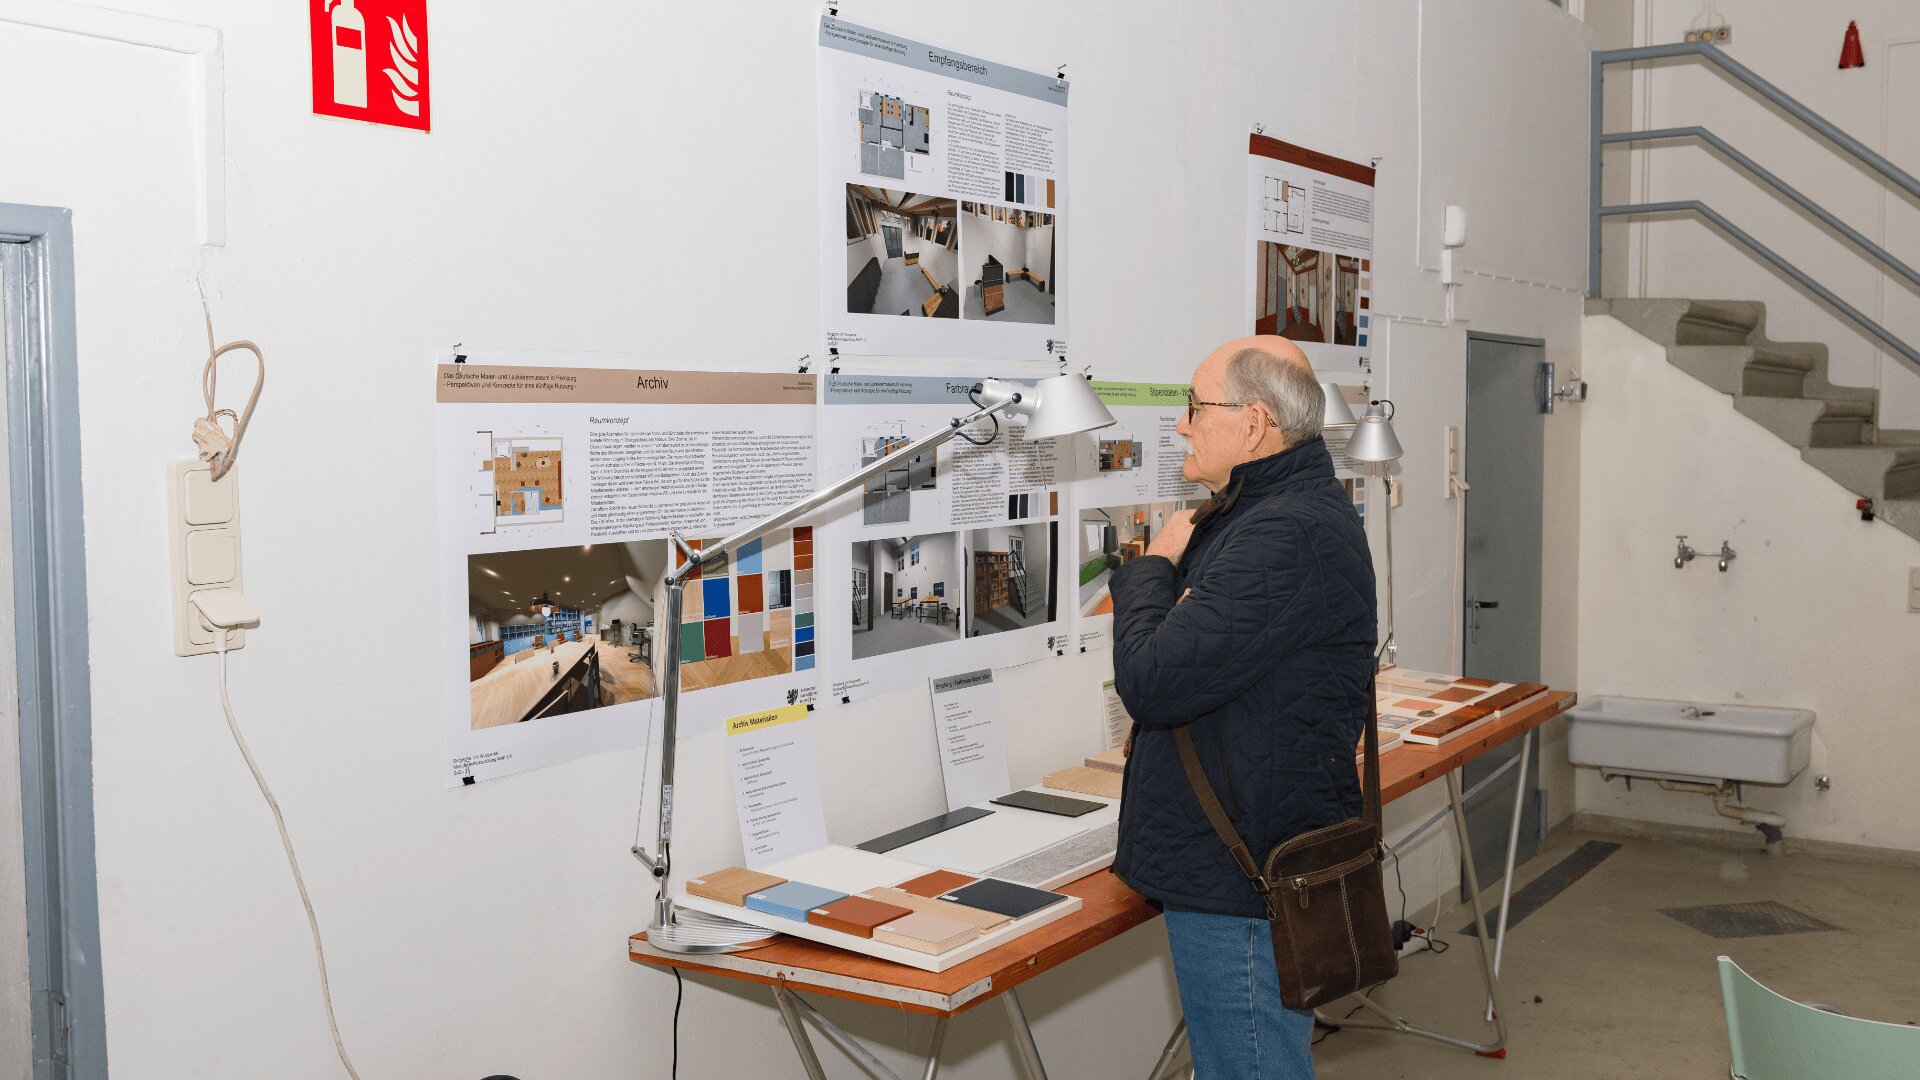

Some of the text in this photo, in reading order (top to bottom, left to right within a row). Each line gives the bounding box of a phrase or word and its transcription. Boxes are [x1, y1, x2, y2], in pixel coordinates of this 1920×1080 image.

[928, 51, 988, 76] Empfangsbereich
[446, 381, 481, 389] Perspektiven
[492, 381, 516, 390] Konzepte
[637, 375, 669, 389] Archiv
[946, 382, 970, 394] Farbra
[1149, 387, 1179, 398] Stipendiaten
[589, 416, 630, 426] Raumkonzept
[732, 714, 778, 730] Archiv Materialien
